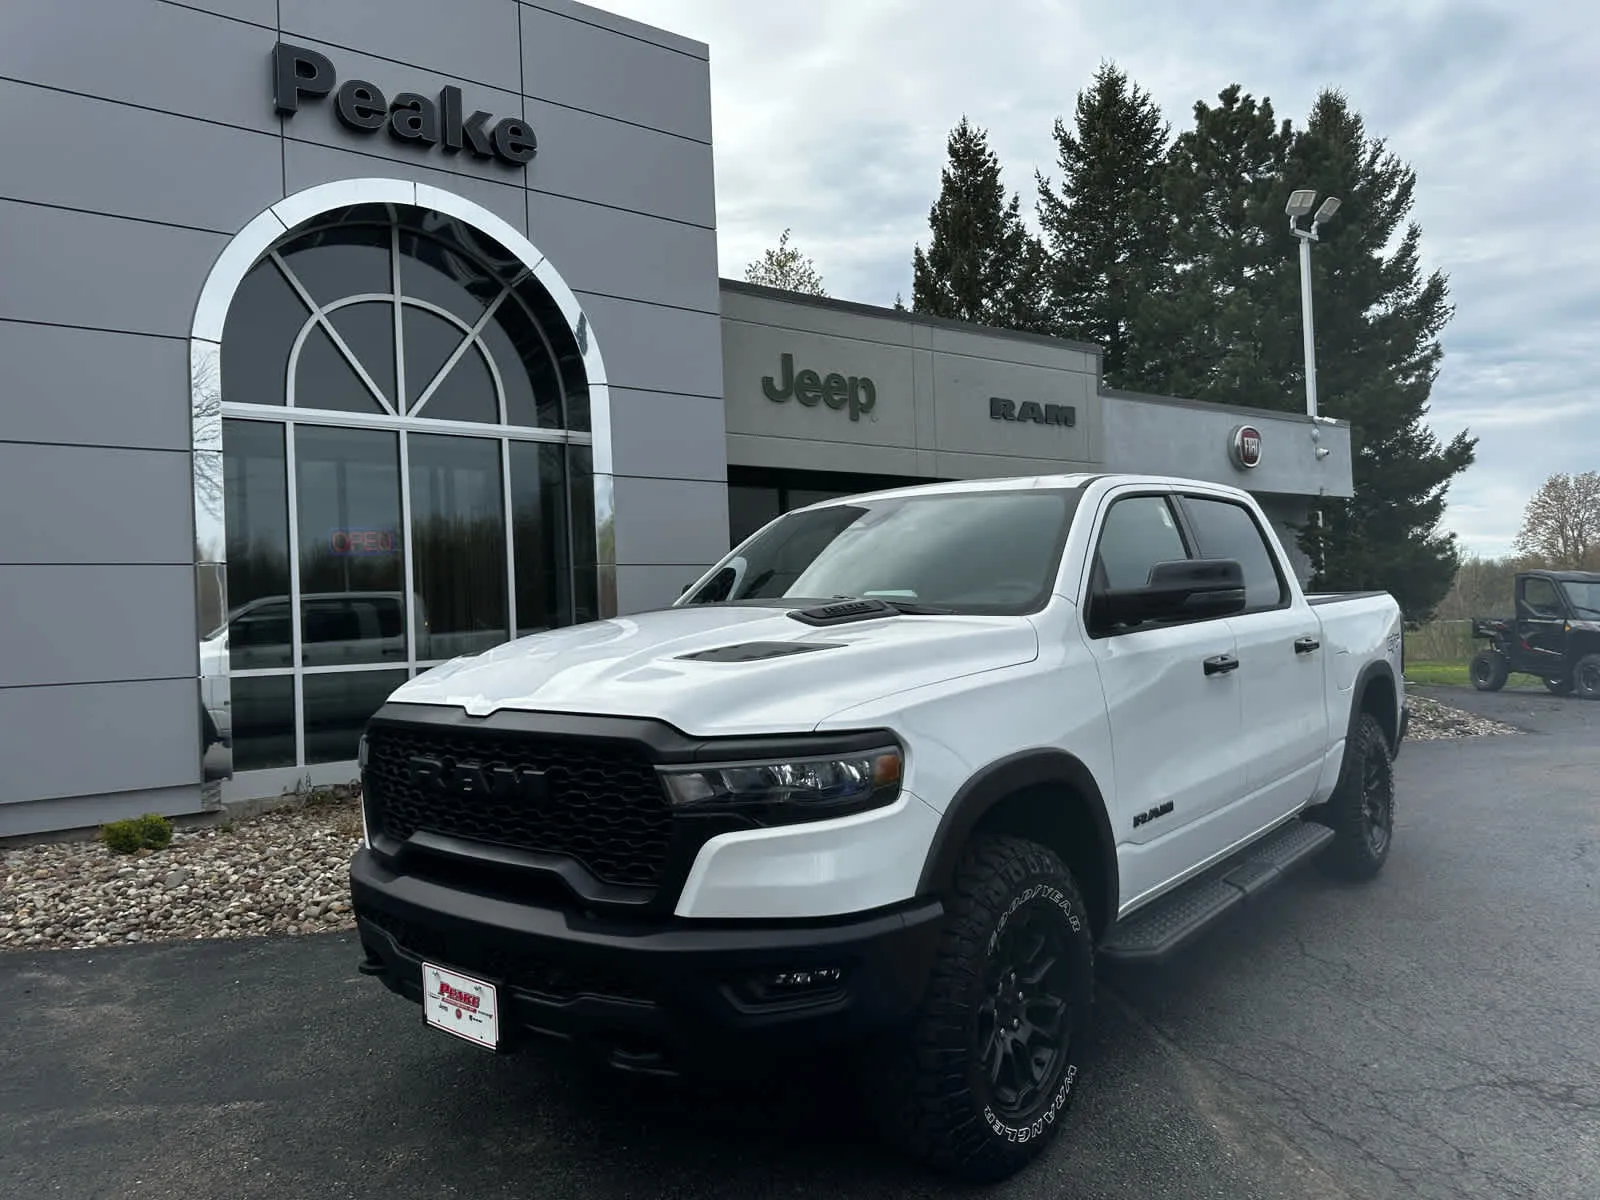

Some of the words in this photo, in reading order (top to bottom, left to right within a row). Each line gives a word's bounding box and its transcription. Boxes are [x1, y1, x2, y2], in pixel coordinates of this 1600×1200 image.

[272, 41, 538, 167] Peake
[762, 353, 876, 421] Jeep
[990, 397, 1076, 427] RAM
[331, 531, 391, 552] OPEN
[1133, 800, 1174, 828] RAM
[987, 884, 1081, 956] GOODYEAR
[984, 1064, 1077, 1142] WRANGLER
